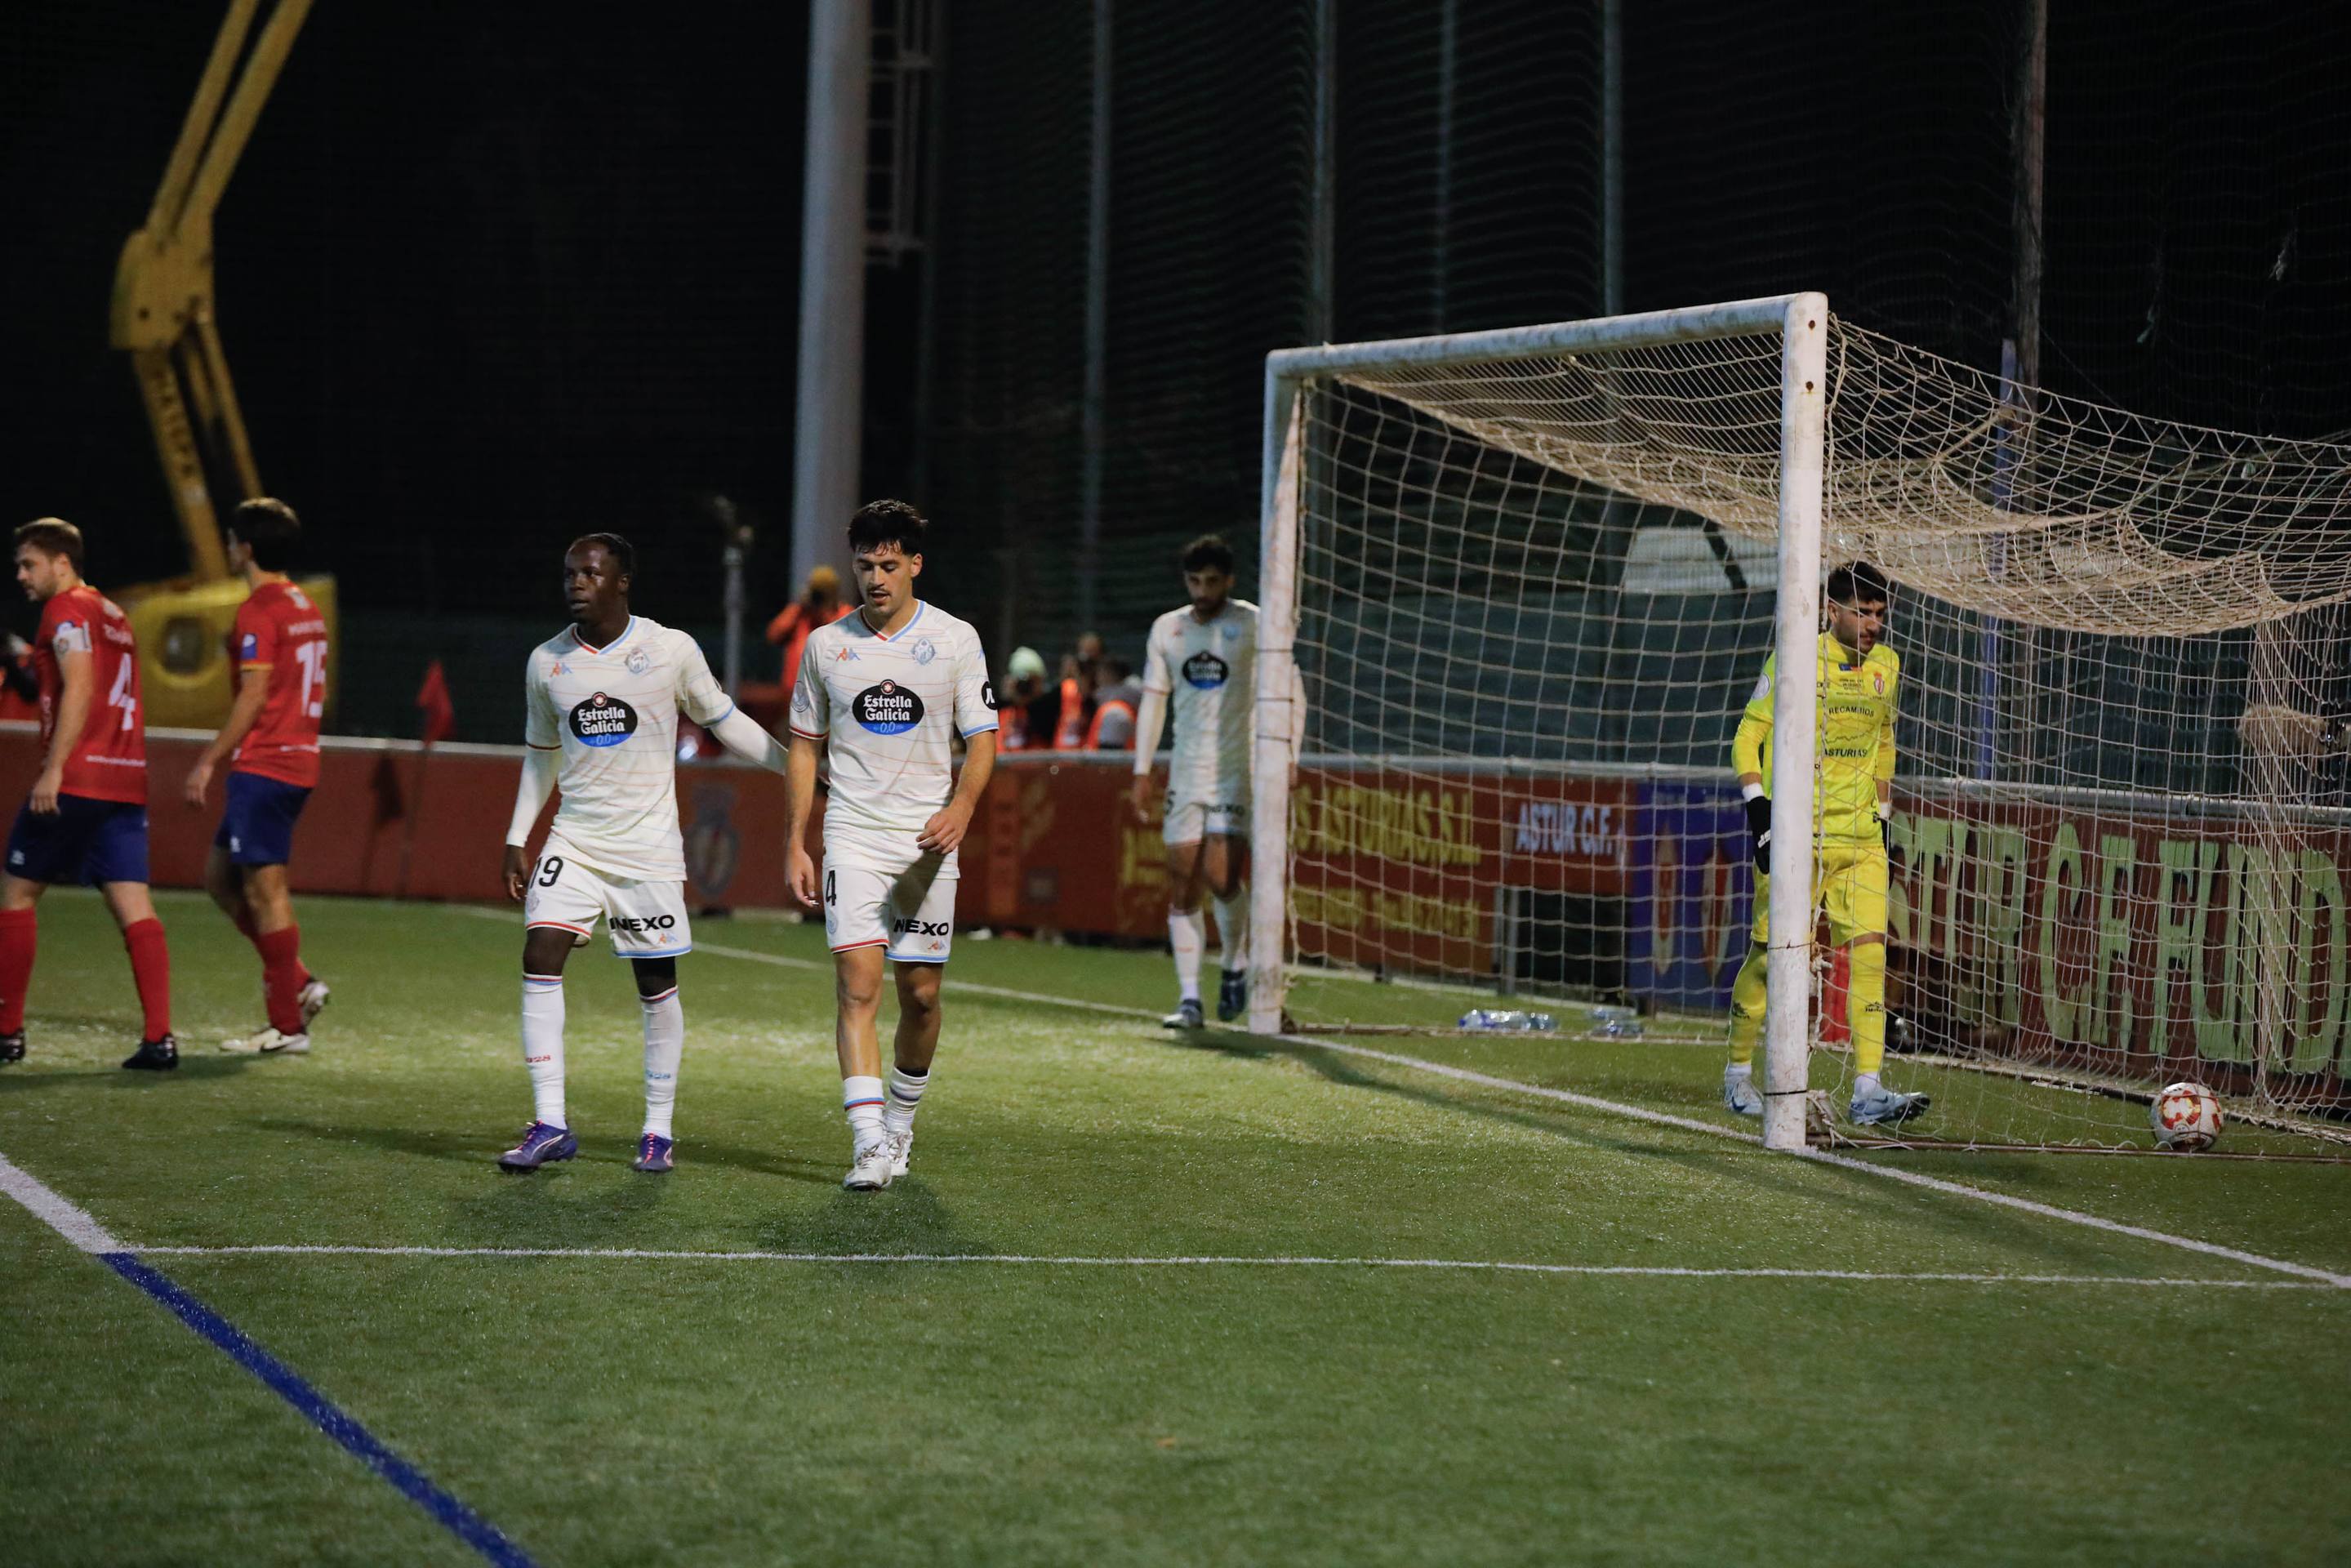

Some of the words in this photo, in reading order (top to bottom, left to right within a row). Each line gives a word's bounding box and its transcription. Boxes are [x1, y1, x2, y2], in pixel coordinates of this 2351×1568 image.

[108, 653, 136, 731] 4
[863, 694, 913, 708] Estrella
[577, 706, 626, 722] Estrella
[866, 707, 911, 721] Galicia
[1828, 706, 1875, 718] RECAMBIOS
[581, 719, 626, 735] Galicia
[1516, 802, 1576, 852] ASTUR
[1580, 804, 1613, 855] C.F.
[530, 856, 563, 888] 19
[826, 870, 837, 906] 4
